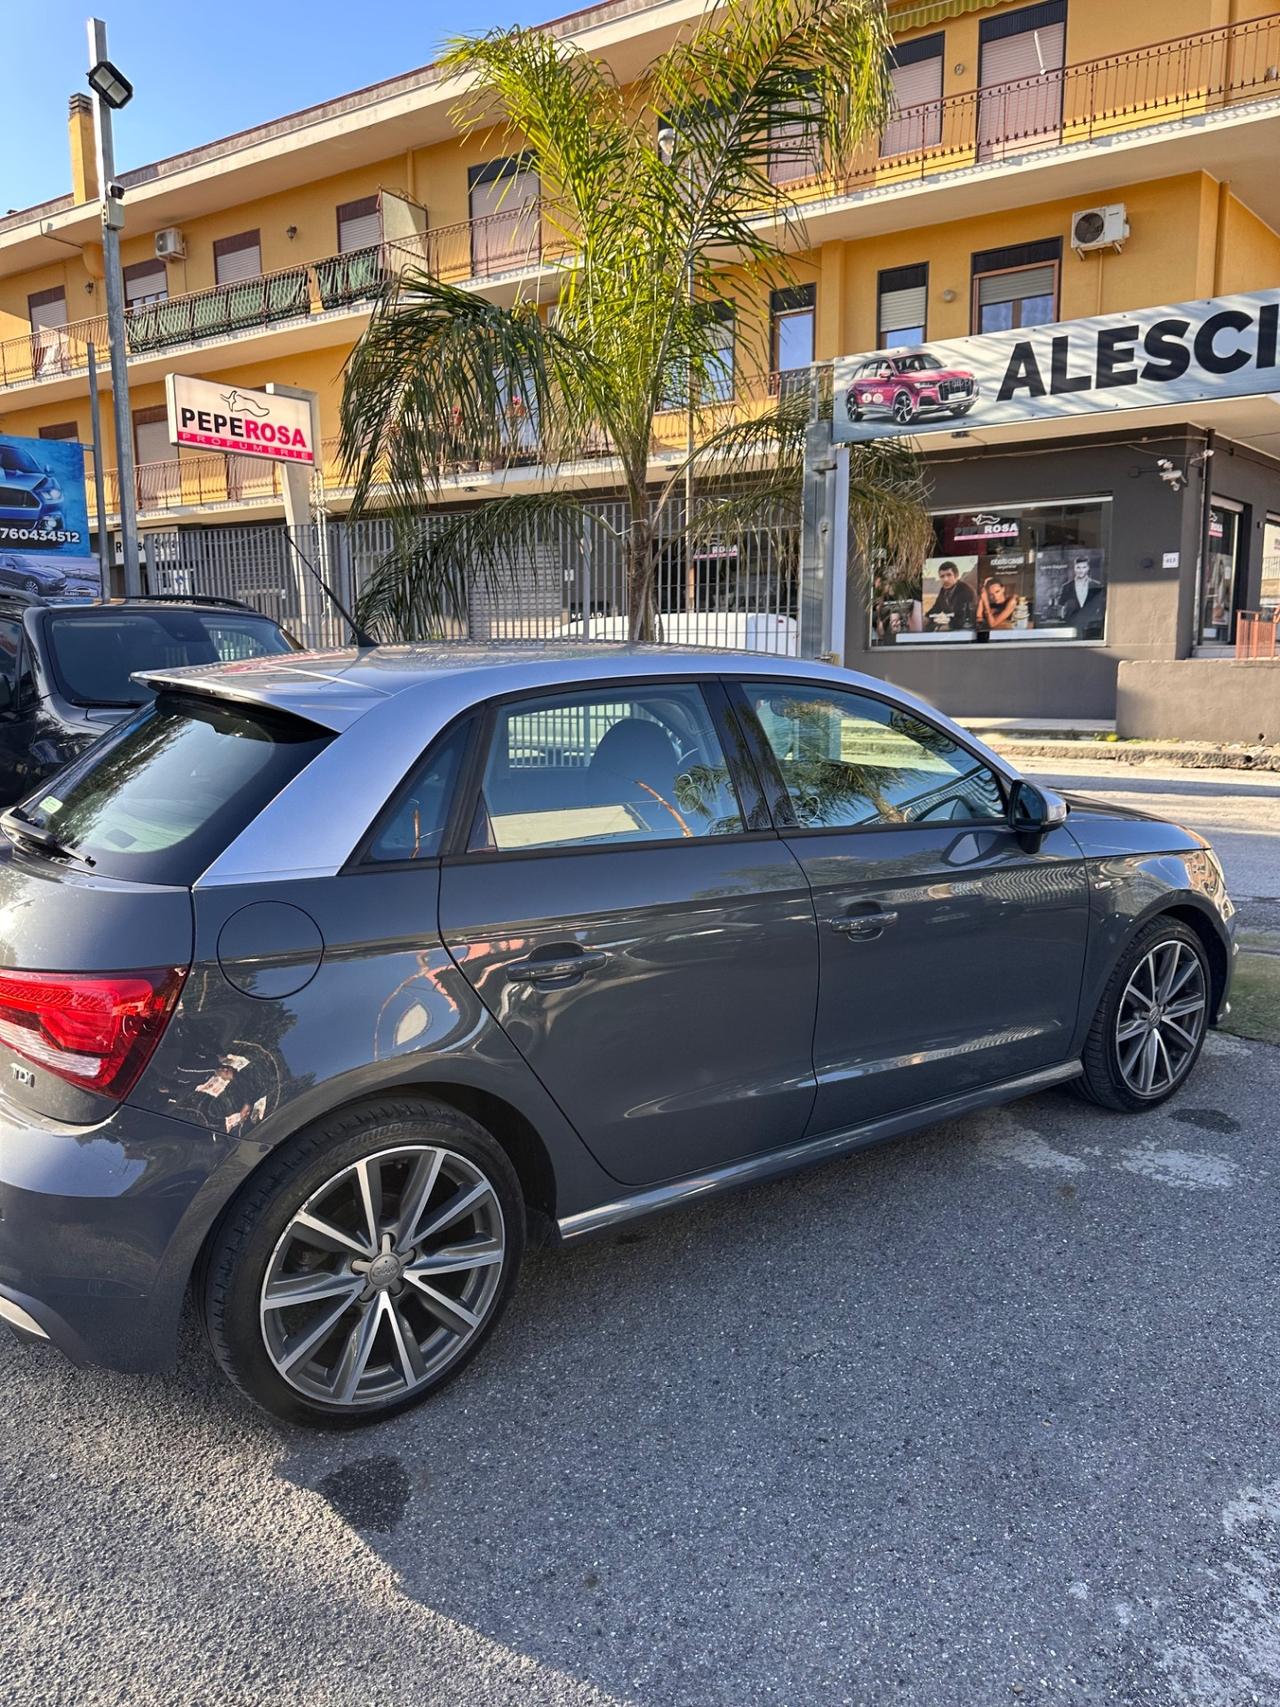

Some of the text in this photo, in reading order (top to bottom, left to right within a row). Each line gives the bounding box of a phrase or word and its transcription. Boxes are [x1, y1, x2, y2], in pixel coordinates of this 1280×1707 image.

[996, 303, 1280, 402] ALESCI
[181, 407, 307, 448] PEPEROSA
[182, 432, 310, 460] PROFUMERIE
[0, 527, 80, 543] 760434512
